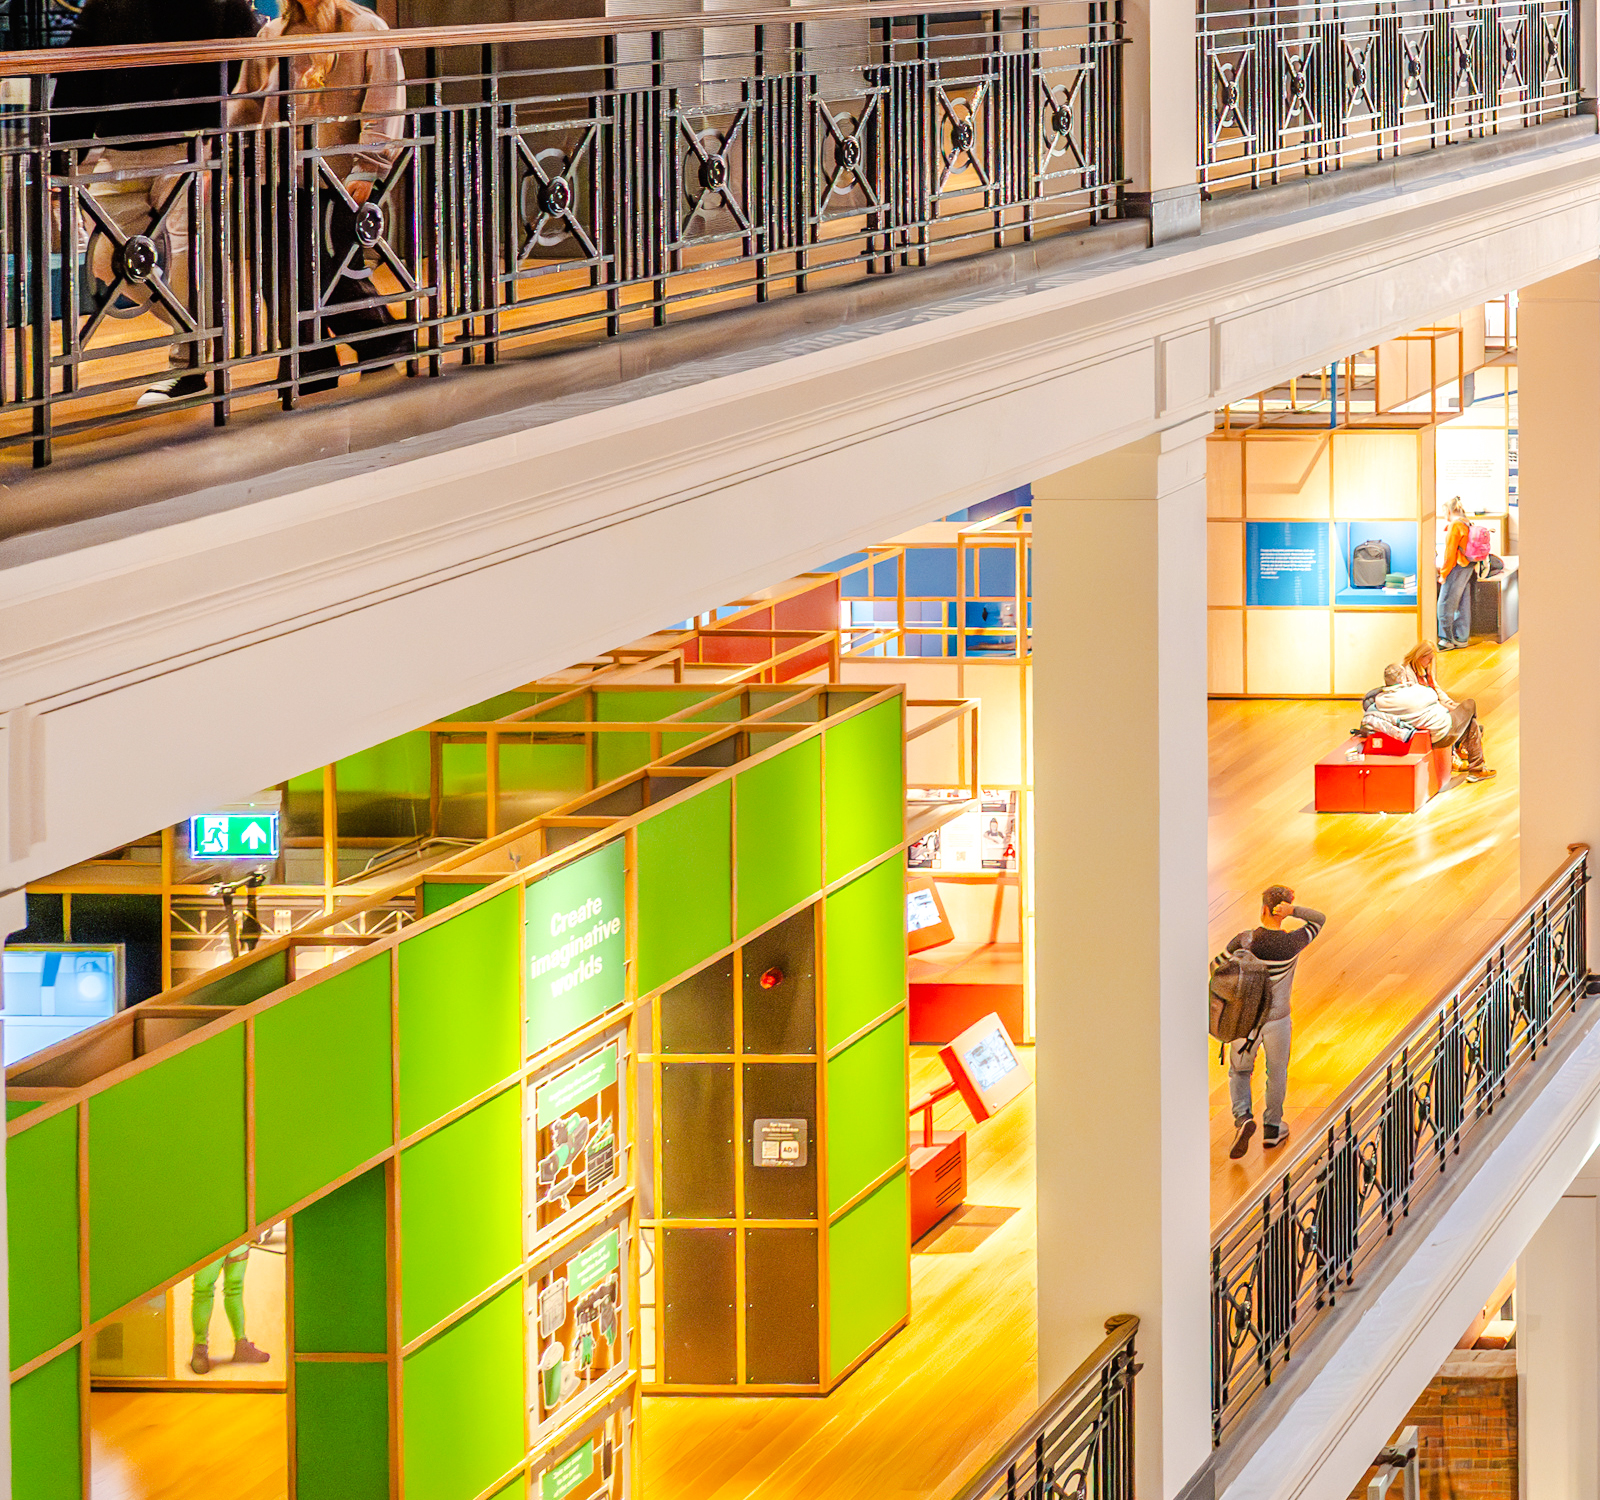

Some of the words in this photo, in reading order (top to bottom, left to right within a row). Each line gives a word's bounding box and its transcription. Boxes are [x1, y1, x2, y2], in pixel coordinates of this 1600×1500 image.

[550, 897, 603, 937] Create
[530, 916, 622, 980] imaginative
[550, 954, 604, 998] worlds
